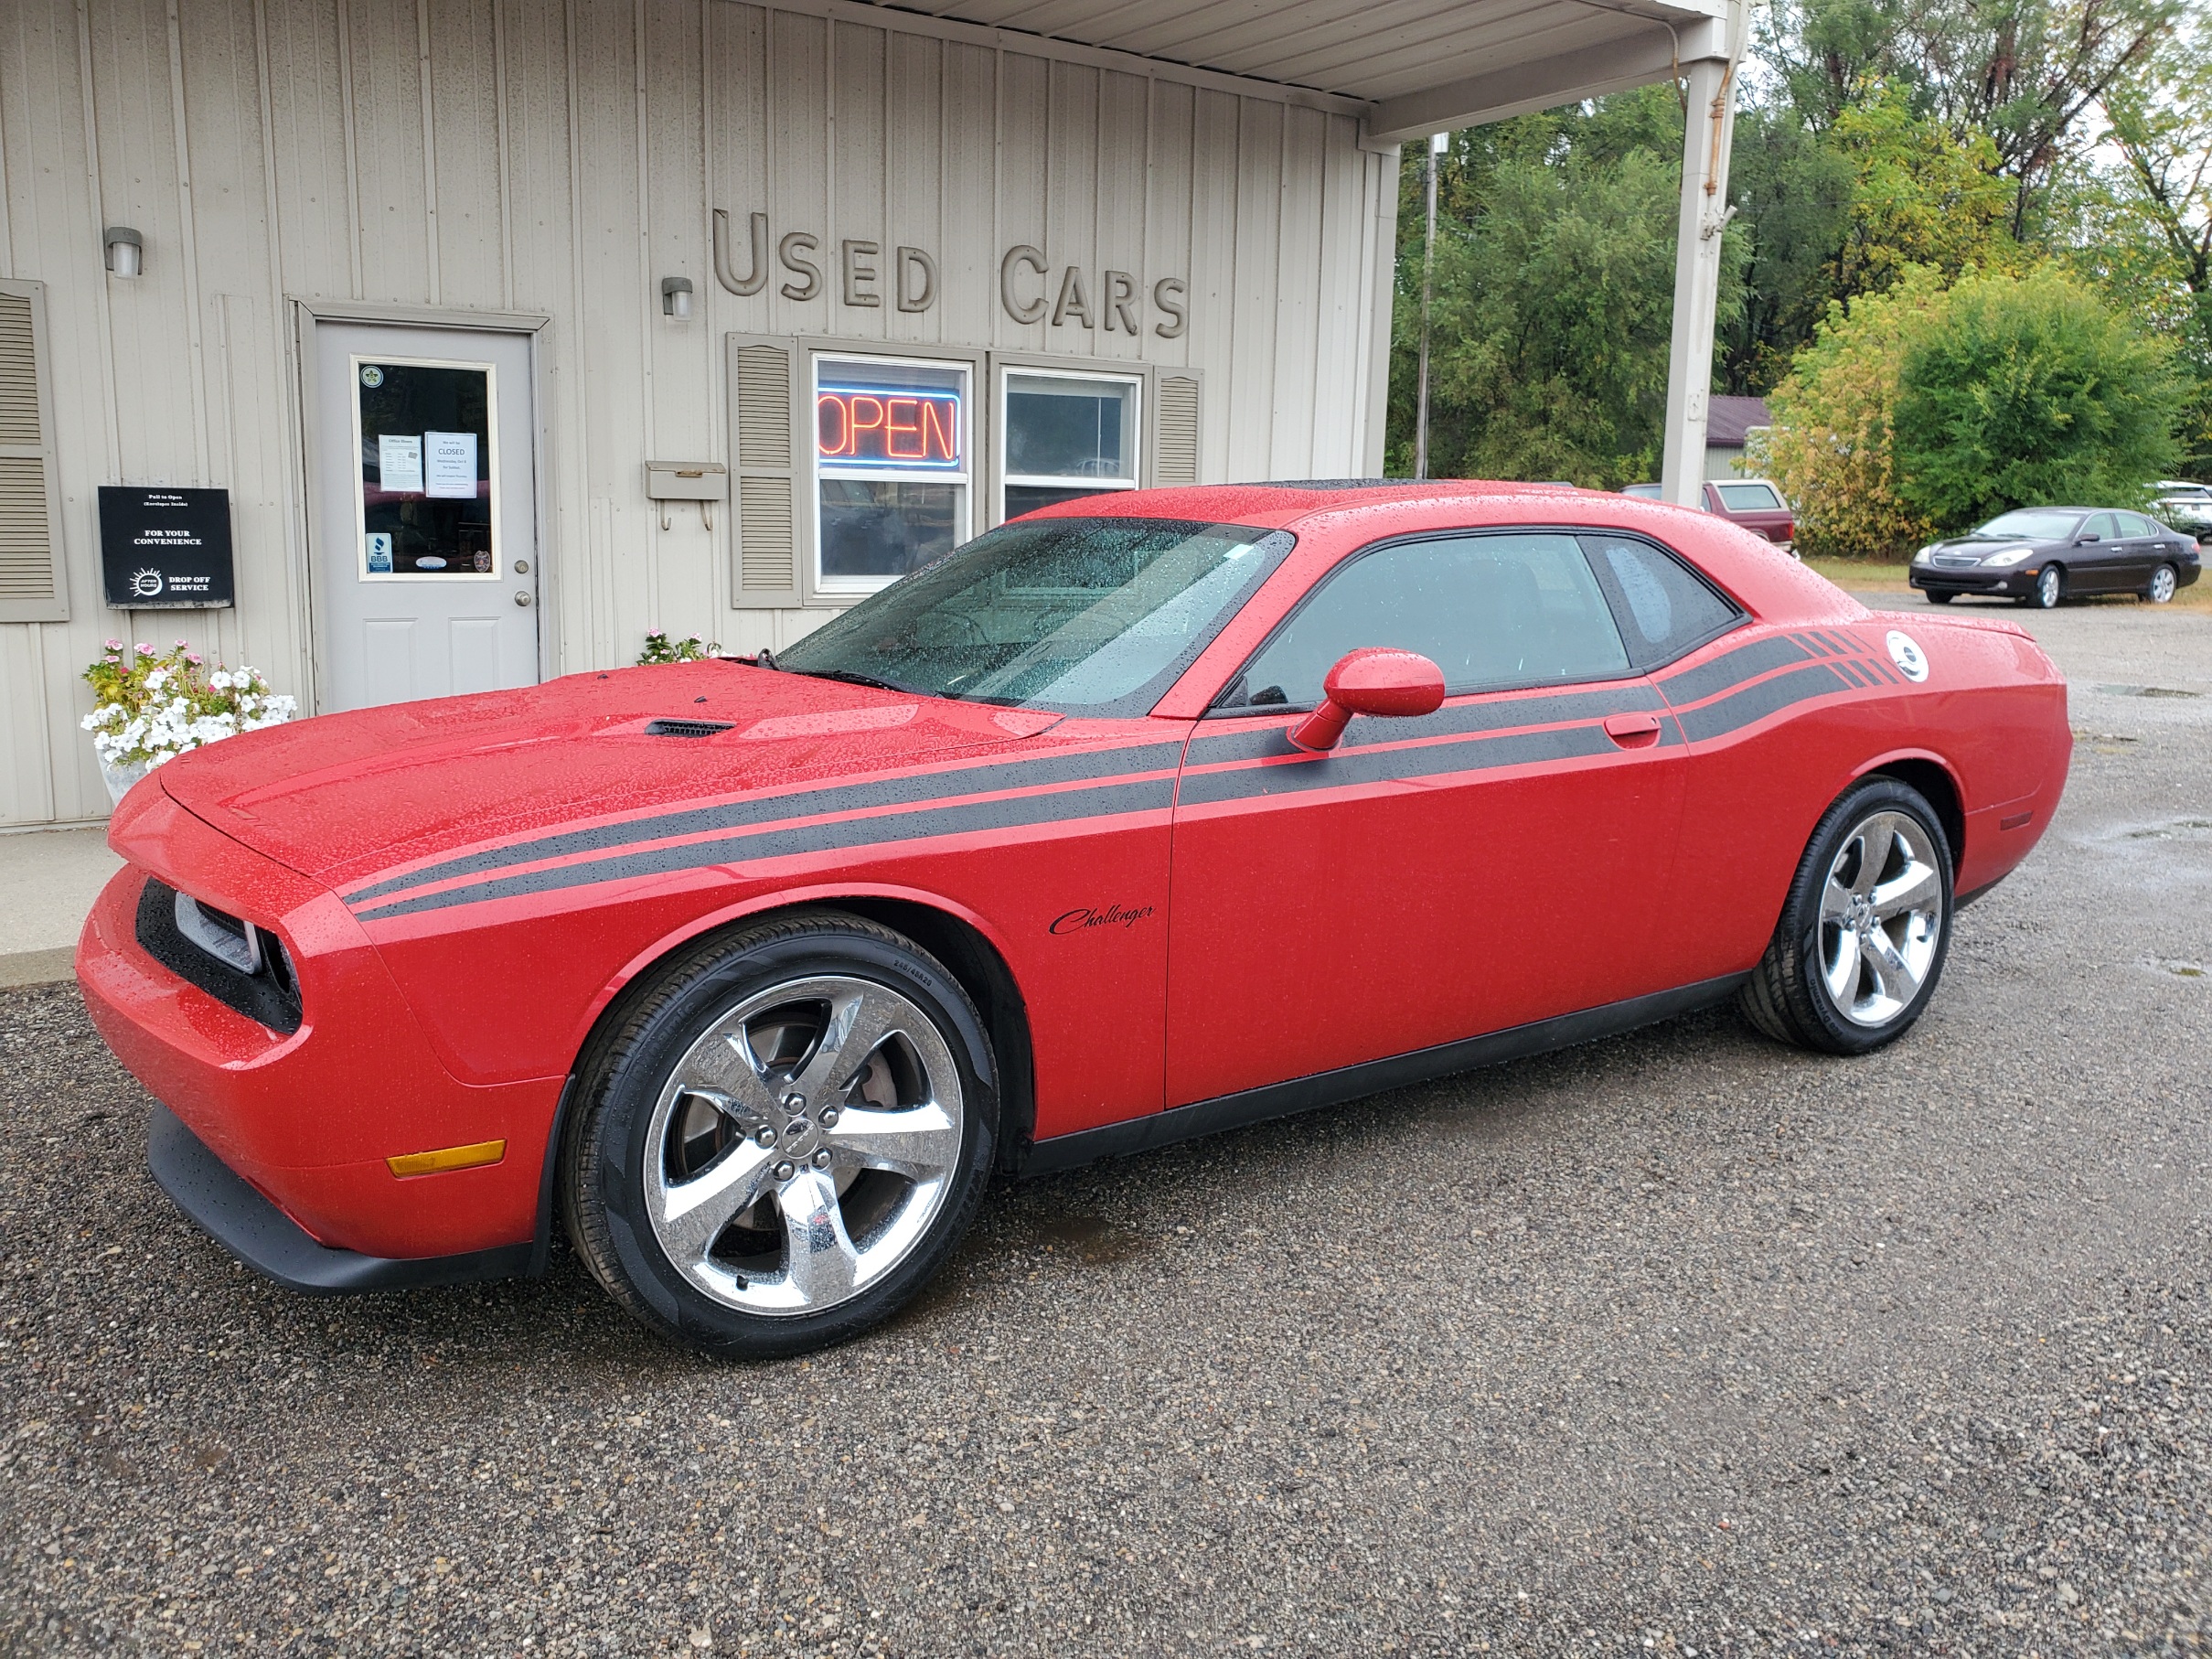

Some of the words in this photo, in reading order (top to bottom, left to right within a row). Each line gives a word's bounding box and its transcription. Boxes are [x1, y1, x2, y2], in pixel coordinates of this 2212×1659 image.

[818, 395, 955, 460] OPEN
[1049, 904, 1156, 936] Challenger
[893, 959, 933, 987] 245/45R20
